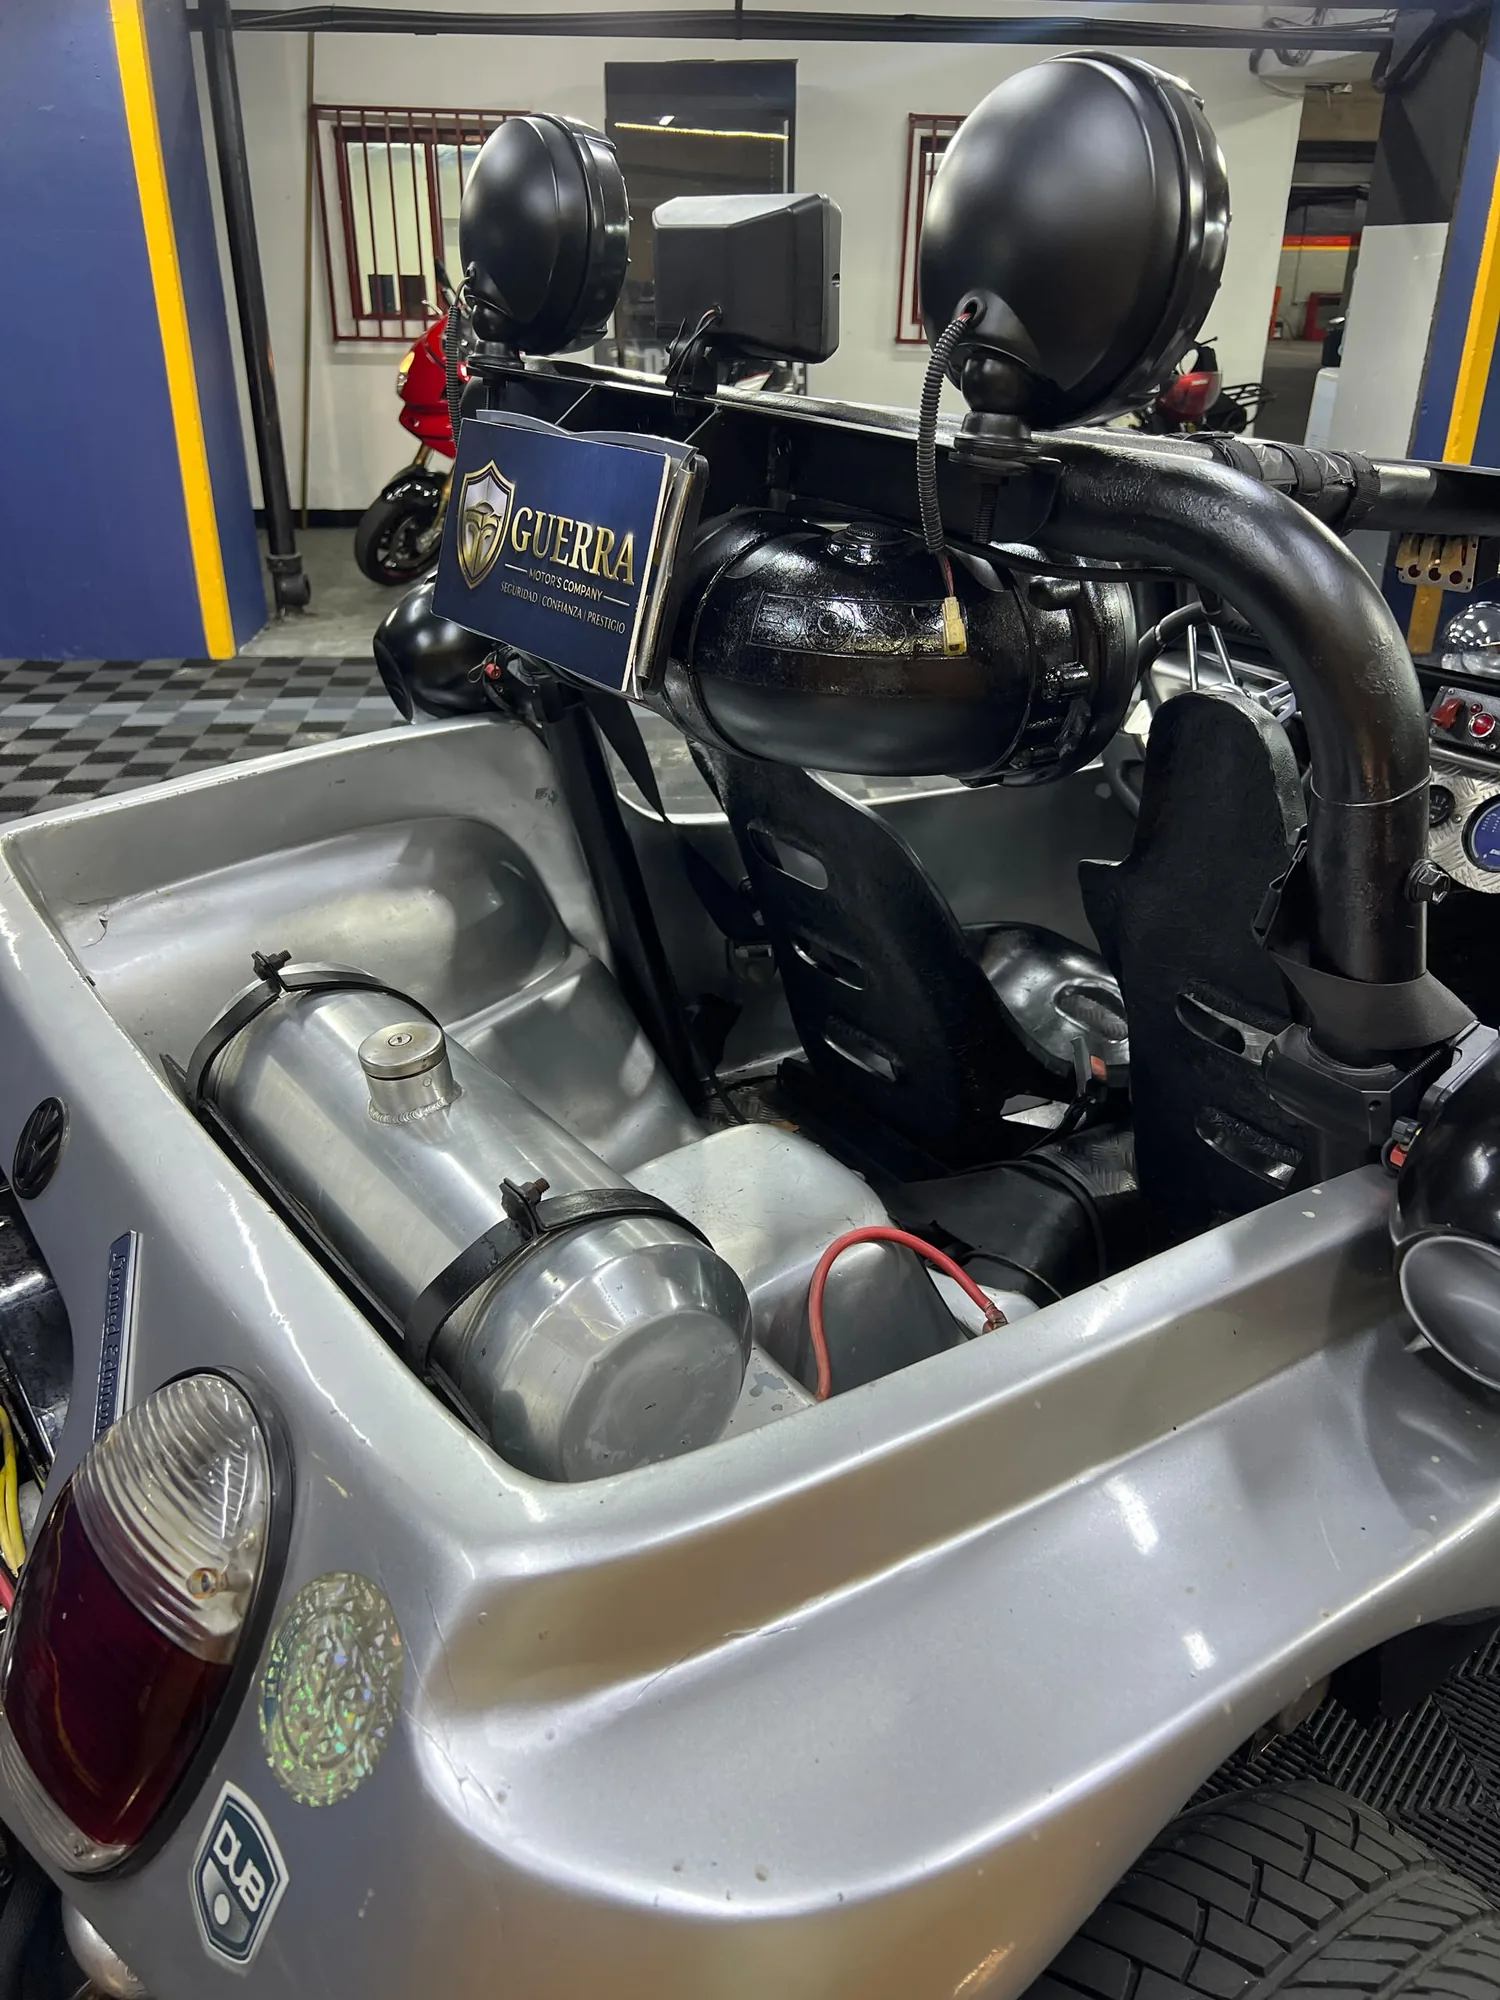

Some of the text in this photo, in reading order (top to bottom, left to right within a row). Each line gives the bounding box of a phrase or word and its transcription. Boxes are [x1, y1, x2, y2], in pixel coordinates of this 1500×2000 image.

[511, 507, 635, 586] GUERRA
[500, 581, 626, 634] SEGURIDAD CONFIANZA PRESTIGIO
[528, 567, 605, 602] MOTOR'S COMPANY
[213, 1819, 265, 1912] DUB
